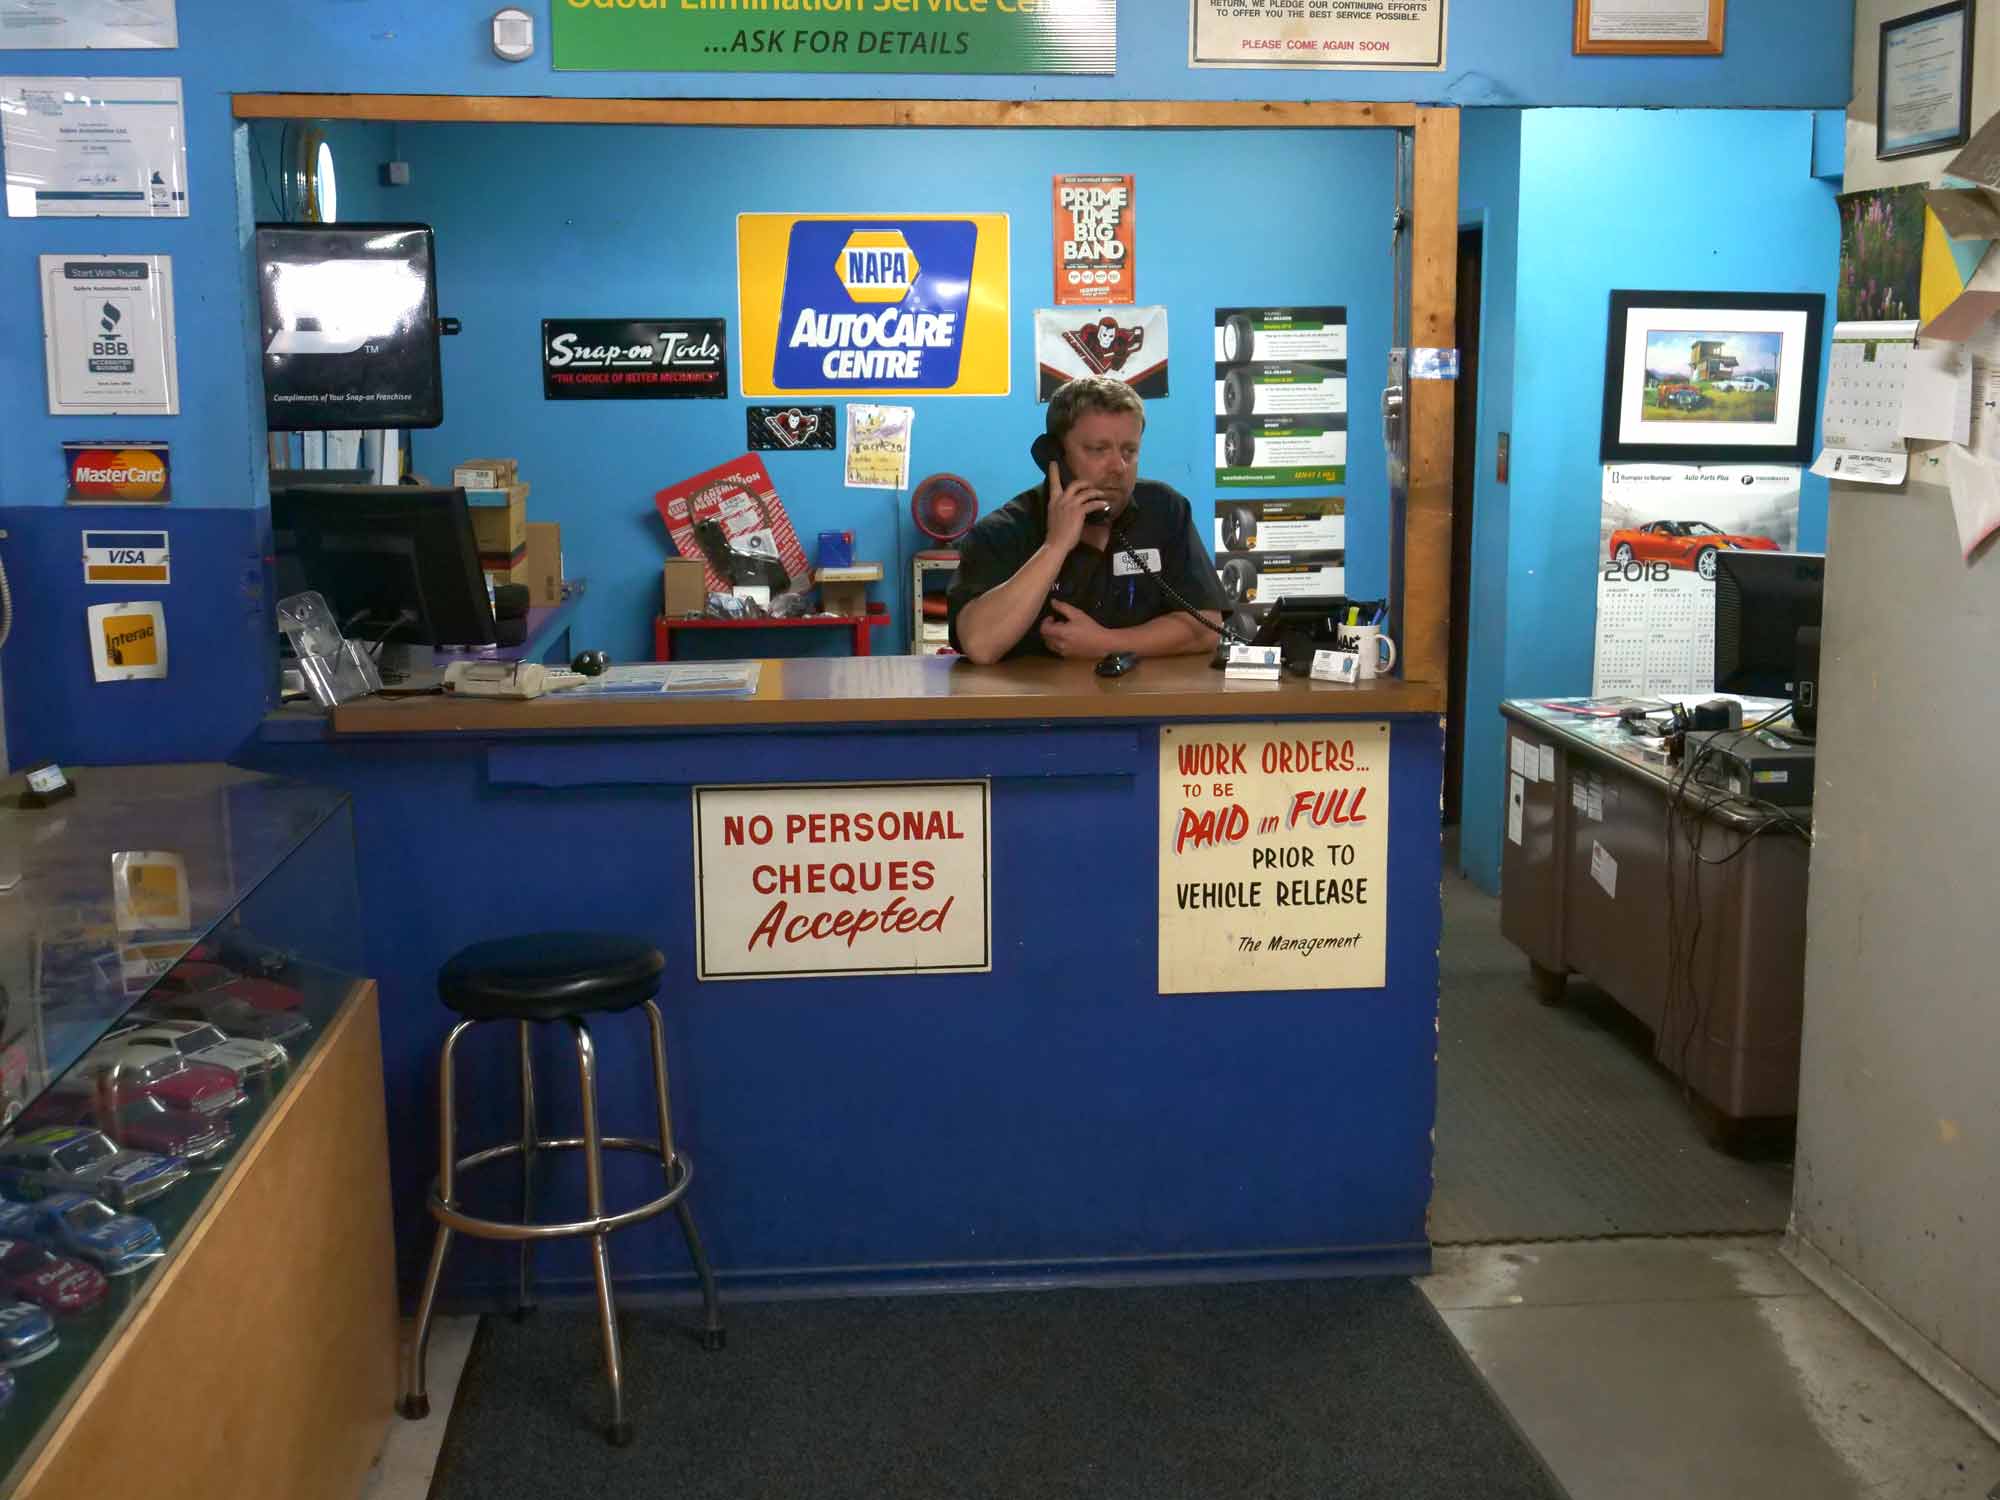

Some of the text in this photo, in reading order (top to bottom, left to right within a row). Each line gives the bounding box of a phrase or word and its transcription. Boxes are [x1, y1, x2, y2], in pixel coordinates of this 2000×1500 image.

[1210, 0, 1427, 11] RETURN, WE PLEDGE OUR CONTINUING EFFORTS
[1216, 9, 1228, 17] TO
[1232, 9, 1260, 17] OFFER
[1288, 10, 1304, 18] THE
[1309, 10, 1332, 18] BEST
[1336, 11, 1371, 19] SERVICE
[1376, 12, 1420, 20] POSSIBLE.
[704, 29, 969, 55] ...ASK FOR DETAILS
[1242, 39, 1390, 51] PLEASE COME AGAIN SOON
[1060, 187, 1128, 208] PRIME
[1069, 205, 1120, 225] TIME
[1073, 223, 1114, 242] BIG
[1063, 240, 1125, 260] BAND
[71, 268, 139, 278] Start With Trust
[848, 250, 907, 284] NAPA
[93, 342, 129, 355] BBB
[365, 345, 379, 353] TM
[549, 332, 720, 366] Snap-on Tools
[822, 350, 922, 380] CENTRE
[575, 373, 609, 384] CHOICE
[611, 373, 624, 384] OF
[625, 373, 658, 384] BETTER
[273, 394, 319, 402] Compliments
[320, 393, 328, 402] of
[346, 393, 374, 402] Snap-on
[376, 393, 412, 401] Franchisee
[76, 467, 162, 483] MasterCard
[109, 550, 145, 564] VISA
[1604, 561, 1671, 582] 2018
[106, 626, 154, 649] Interac
[1178, 740, 1369, 776] WORK ORDERS...
[1183, 783, 1234, 798] TO BE
[724, 811, 964, 846] NO PERSONAL
[1176, 787, 1367, 854] PAID in FULL
[1253, 845, 1354, 869] PRIOR TO
[752, 861, 935, 894] CHEQUES
[1177, 878, 1367, 910] VEHICLE RELEASE
[747, 895, 954, 952] Accepted
[1238, 932, 1360, 957] The Management
